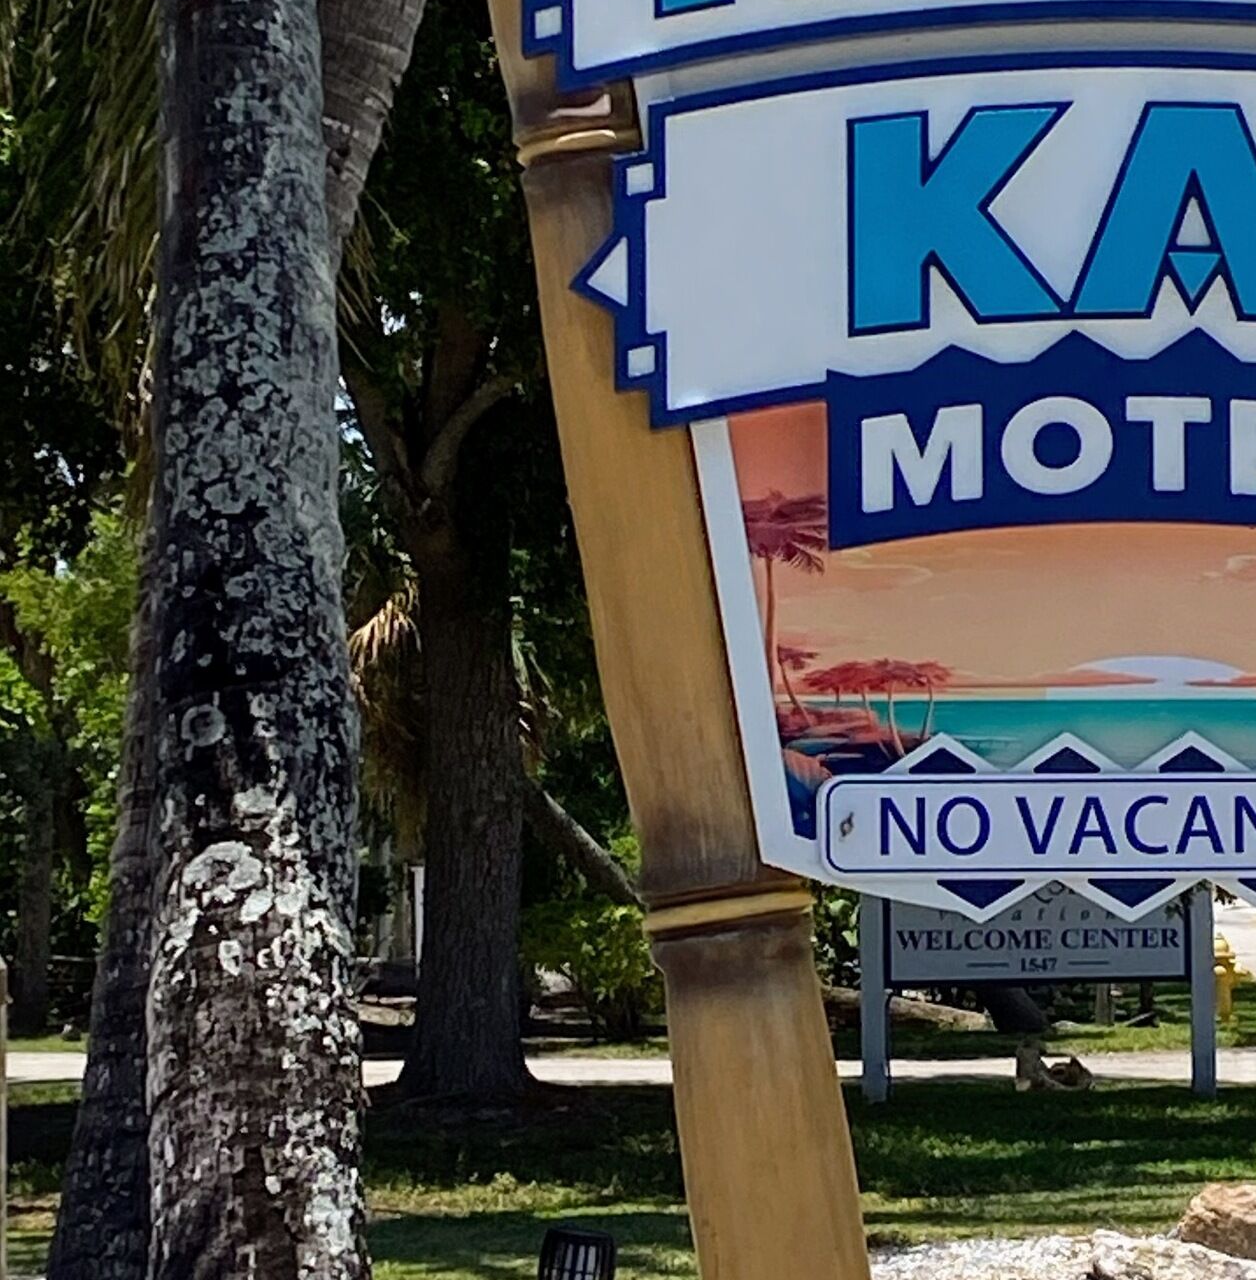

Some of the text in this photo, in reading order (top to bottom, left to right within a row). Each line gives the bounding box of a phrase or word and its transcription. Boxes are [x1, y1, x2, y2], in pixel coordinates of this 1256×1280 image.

[878, 795, 992, 857] NO
[896, 927, 1181, 951] WELCOME CENTER
[1019, 957, 1059, 973] 1547
